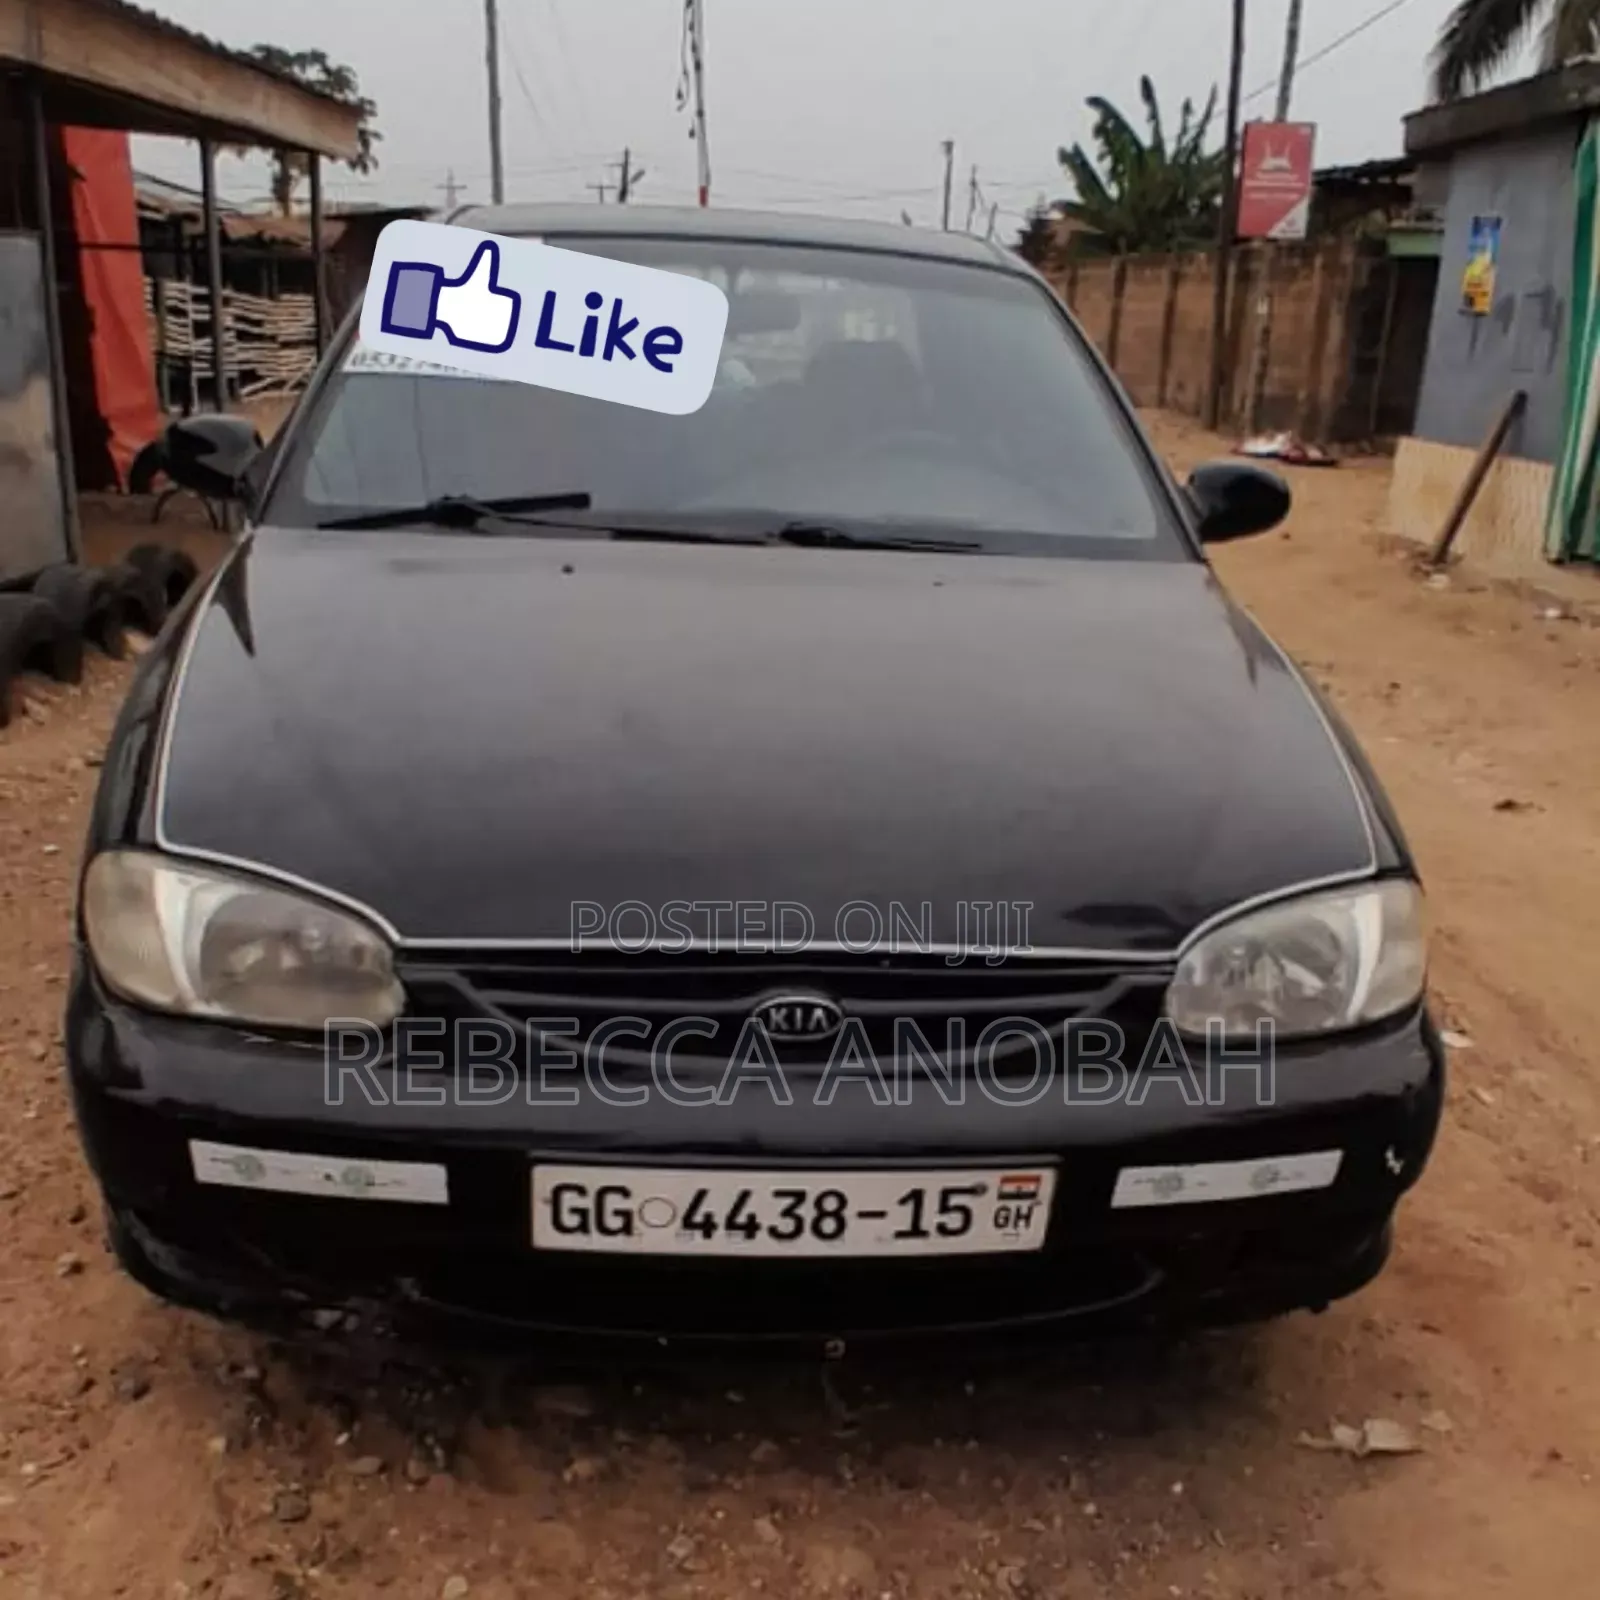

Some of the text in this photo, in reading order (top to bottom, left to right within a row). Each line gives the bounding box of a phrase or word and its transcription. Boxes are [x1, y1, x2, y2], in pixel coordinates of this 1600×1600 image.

[768, 1007, 829, 1032] KIA
[549, 1182, 977, 1242] GG 4438-15
[993, 1204, 1035, 1231] GH
